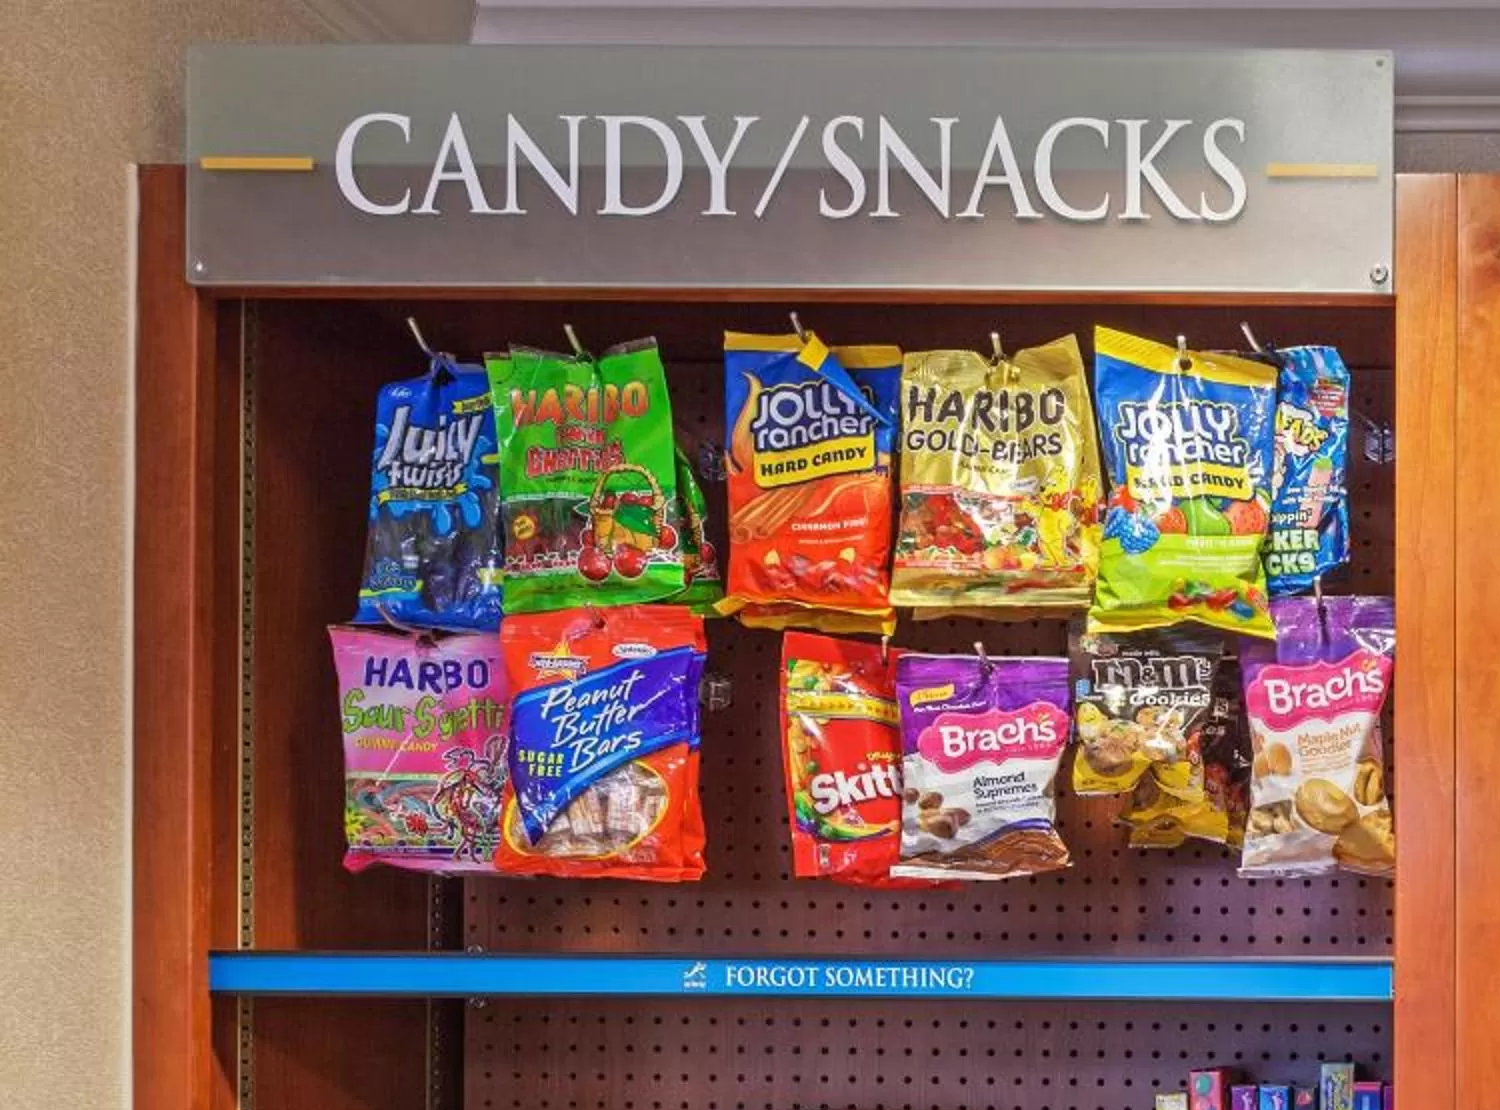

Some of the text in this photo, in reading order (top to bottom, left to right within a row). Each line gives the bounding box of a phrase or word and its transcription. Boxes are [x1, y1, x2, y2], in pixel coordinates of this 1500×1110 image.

[335, 111, 1248, 222] CANDY/SNACKS
[512, 382, 648, 426] HARIBO
[907, 385, 1065, 433] HARIBO
[761, 446, 867, 478] HARD CANDY
[1190, 473, 1246, 490] CANDY
[540, 671, 644, 719] Peanut
[551, 697, 652, 748] Butter
[518, 750, 565, 765] SUGAR
[568, 731, 642, 774] Bars
[529, 764, 563, 779] FREE
[973, 771, 1027, 789] Almond
[725, 966, 975, 990] FORGOT SOMETHING?
